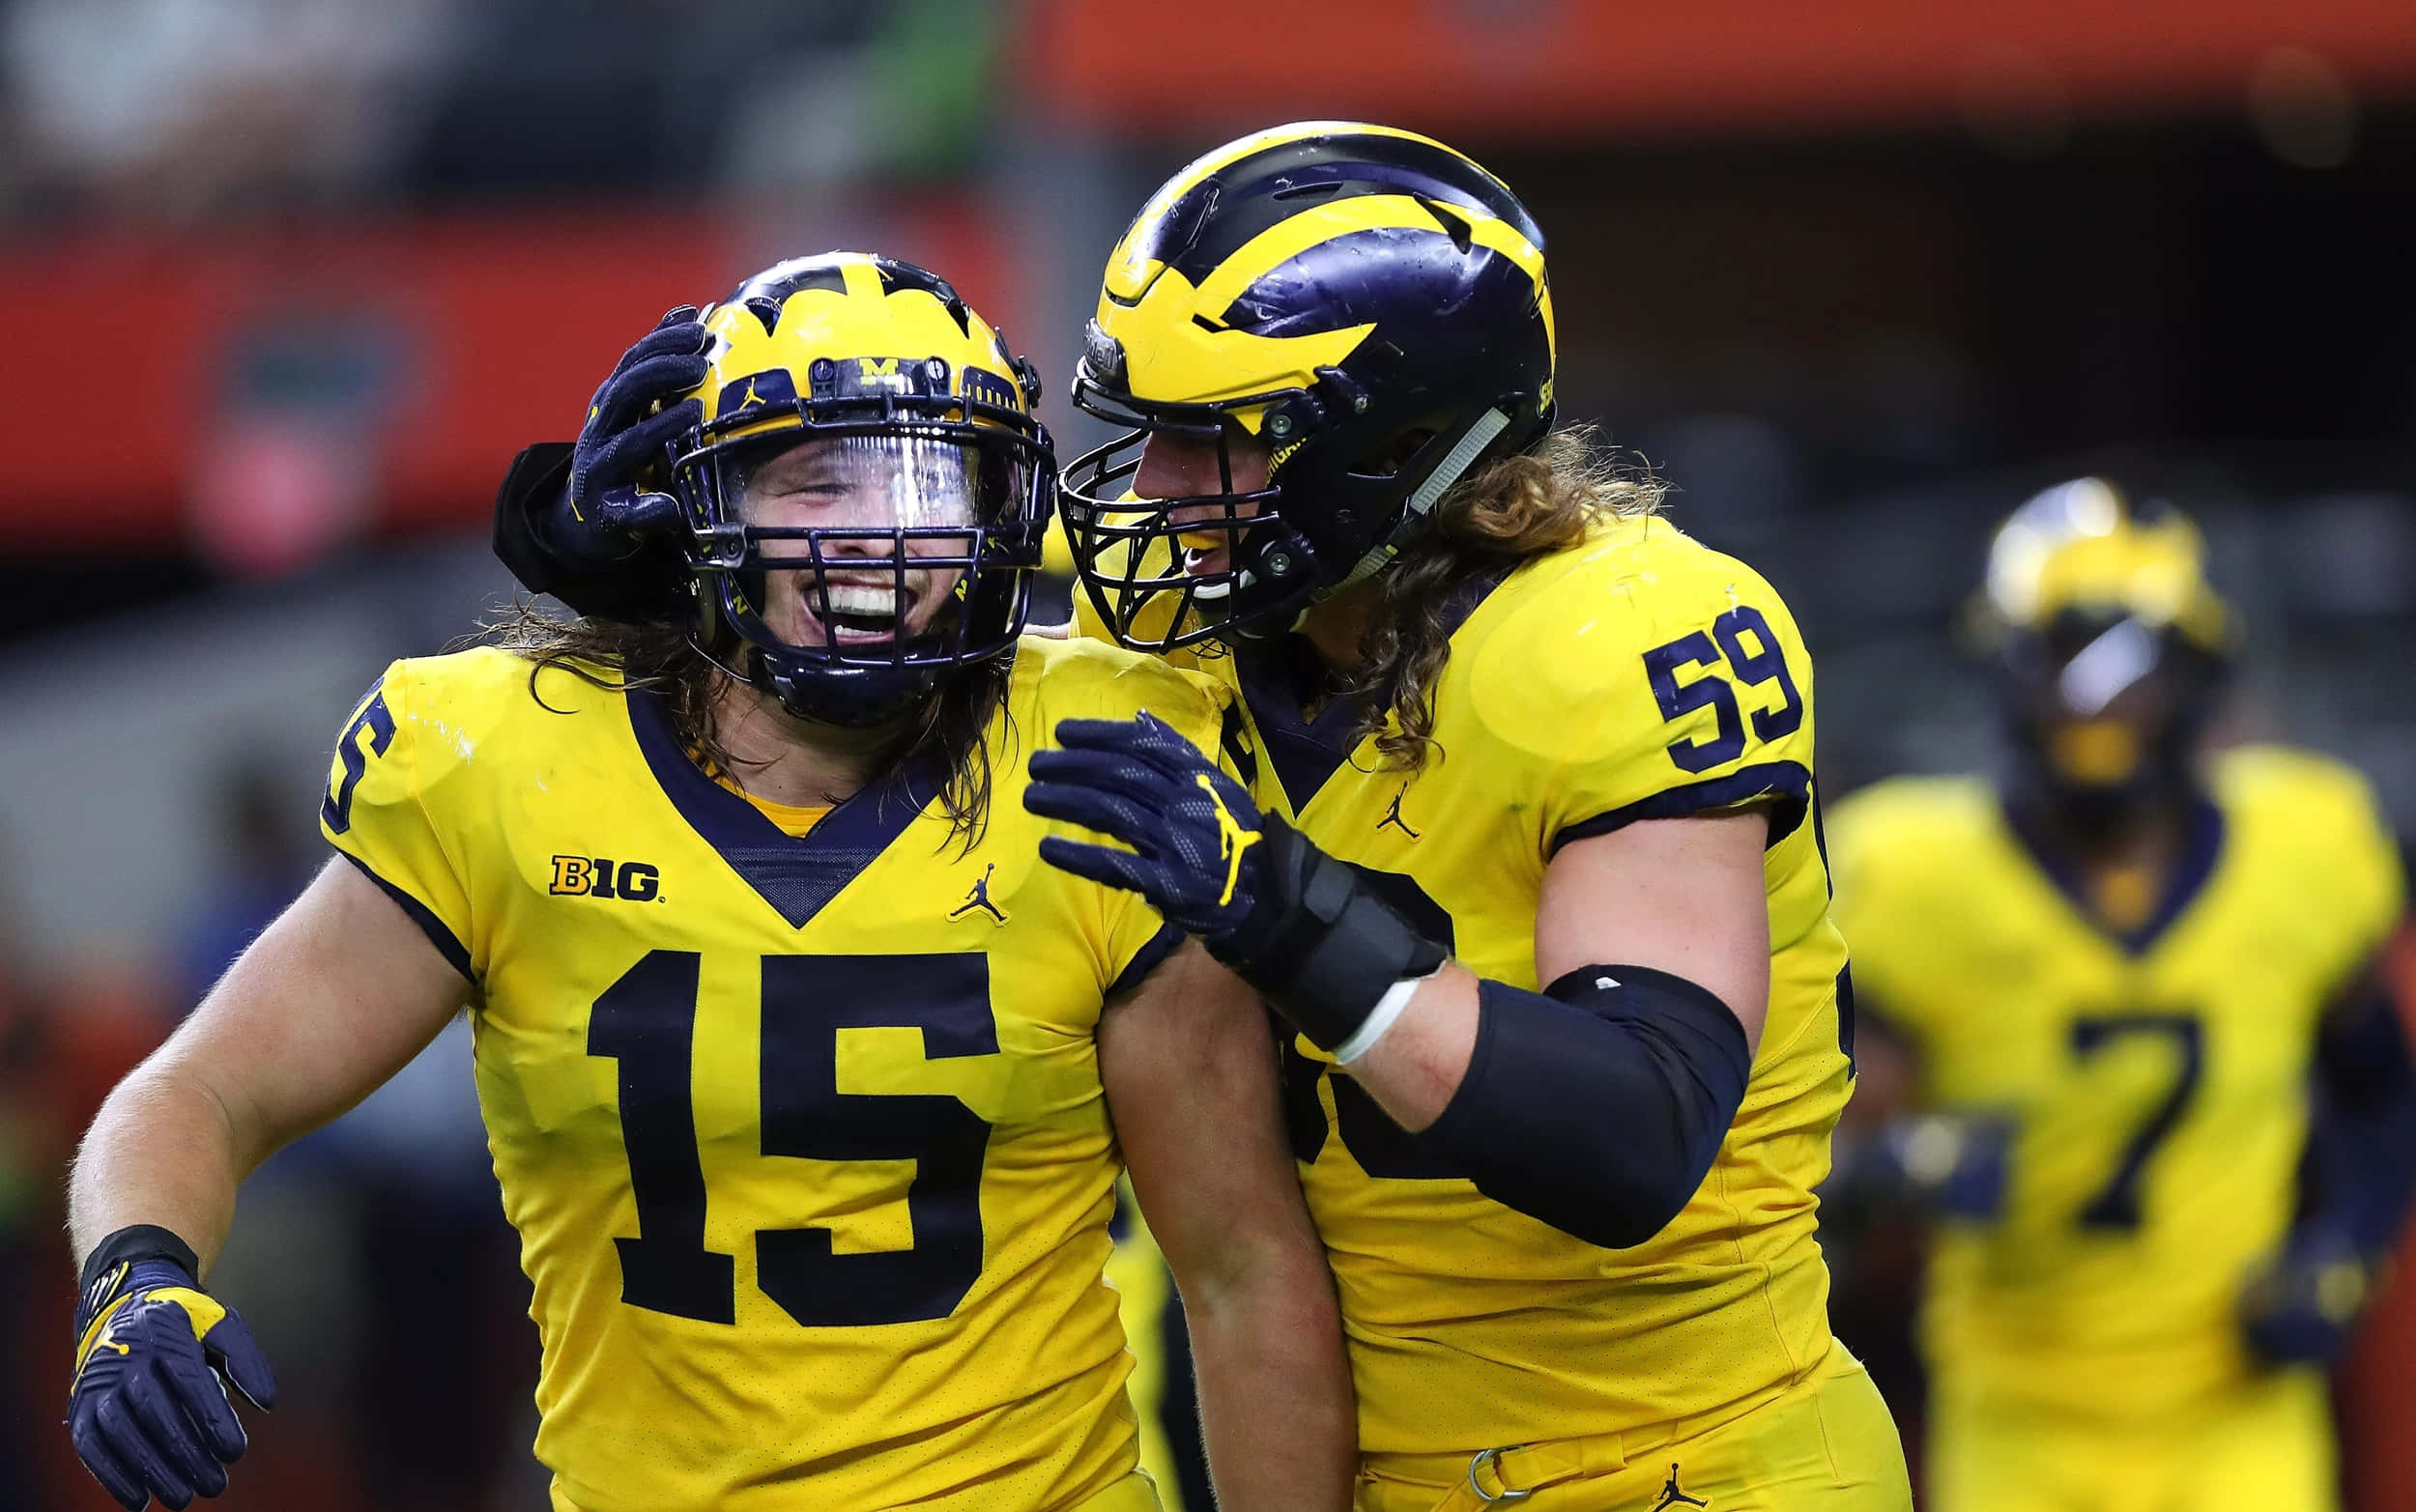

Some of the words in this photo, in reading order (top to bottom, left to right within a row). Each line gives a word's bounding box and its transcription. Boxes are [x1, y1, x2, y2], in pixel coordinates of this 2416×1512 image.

[858, 357, 900, 385] M
[320, 675, 397, 836] 5
[1641, 605, 1804, 775] 59
[587, 949, 1001, 1327] 15
[2068, 1013, 2202, 1230] 7
